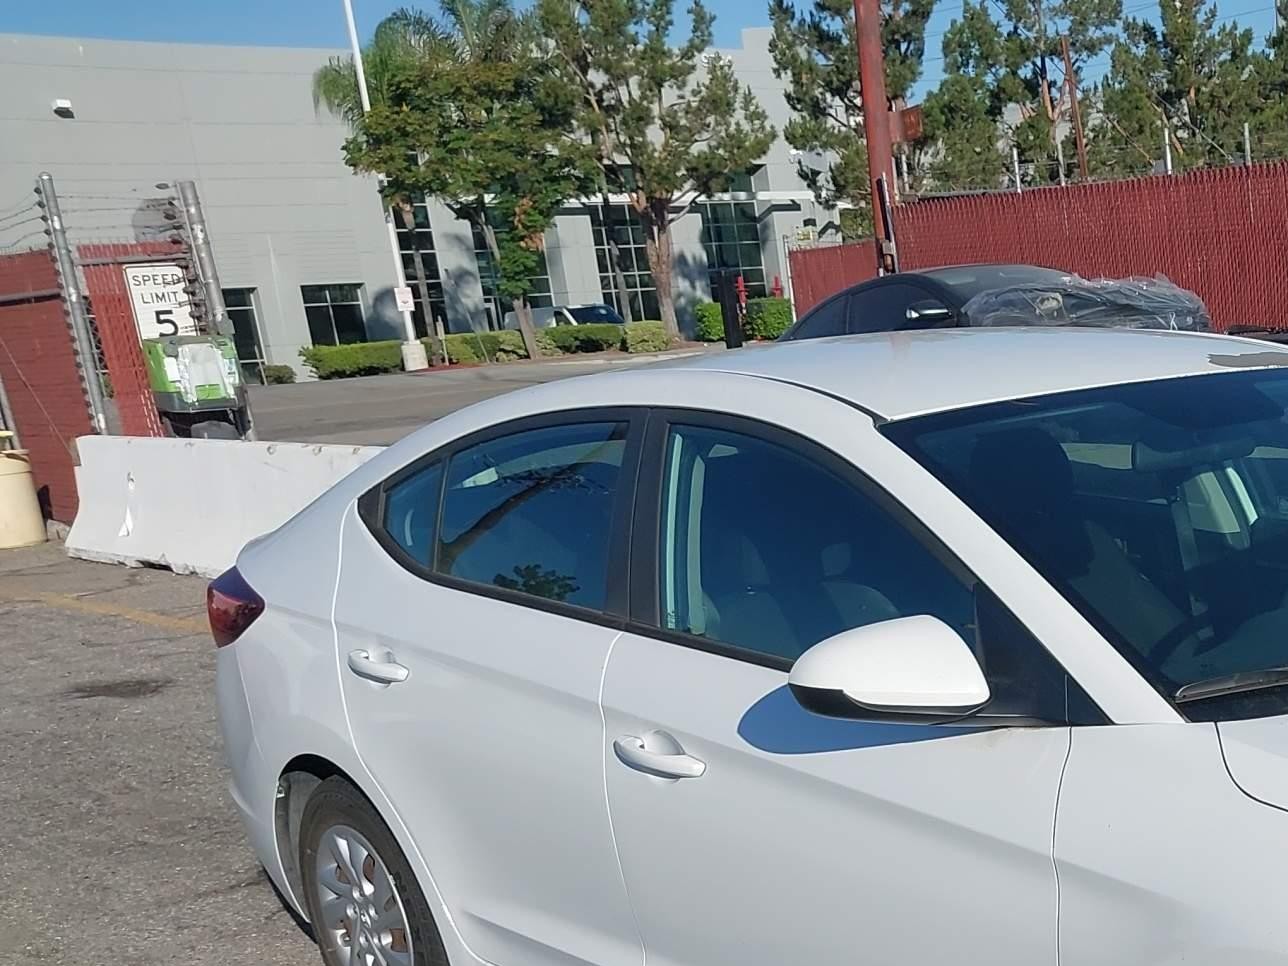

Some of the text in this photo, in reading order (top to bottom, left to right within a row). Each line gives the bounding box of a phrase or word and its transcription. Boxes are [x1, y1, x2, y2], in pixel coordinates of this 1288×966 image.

[132, 273, 182, 286] SPEED
[141, 291, 178, 304] LIMIT
[155, 310, 179, 337] 5
